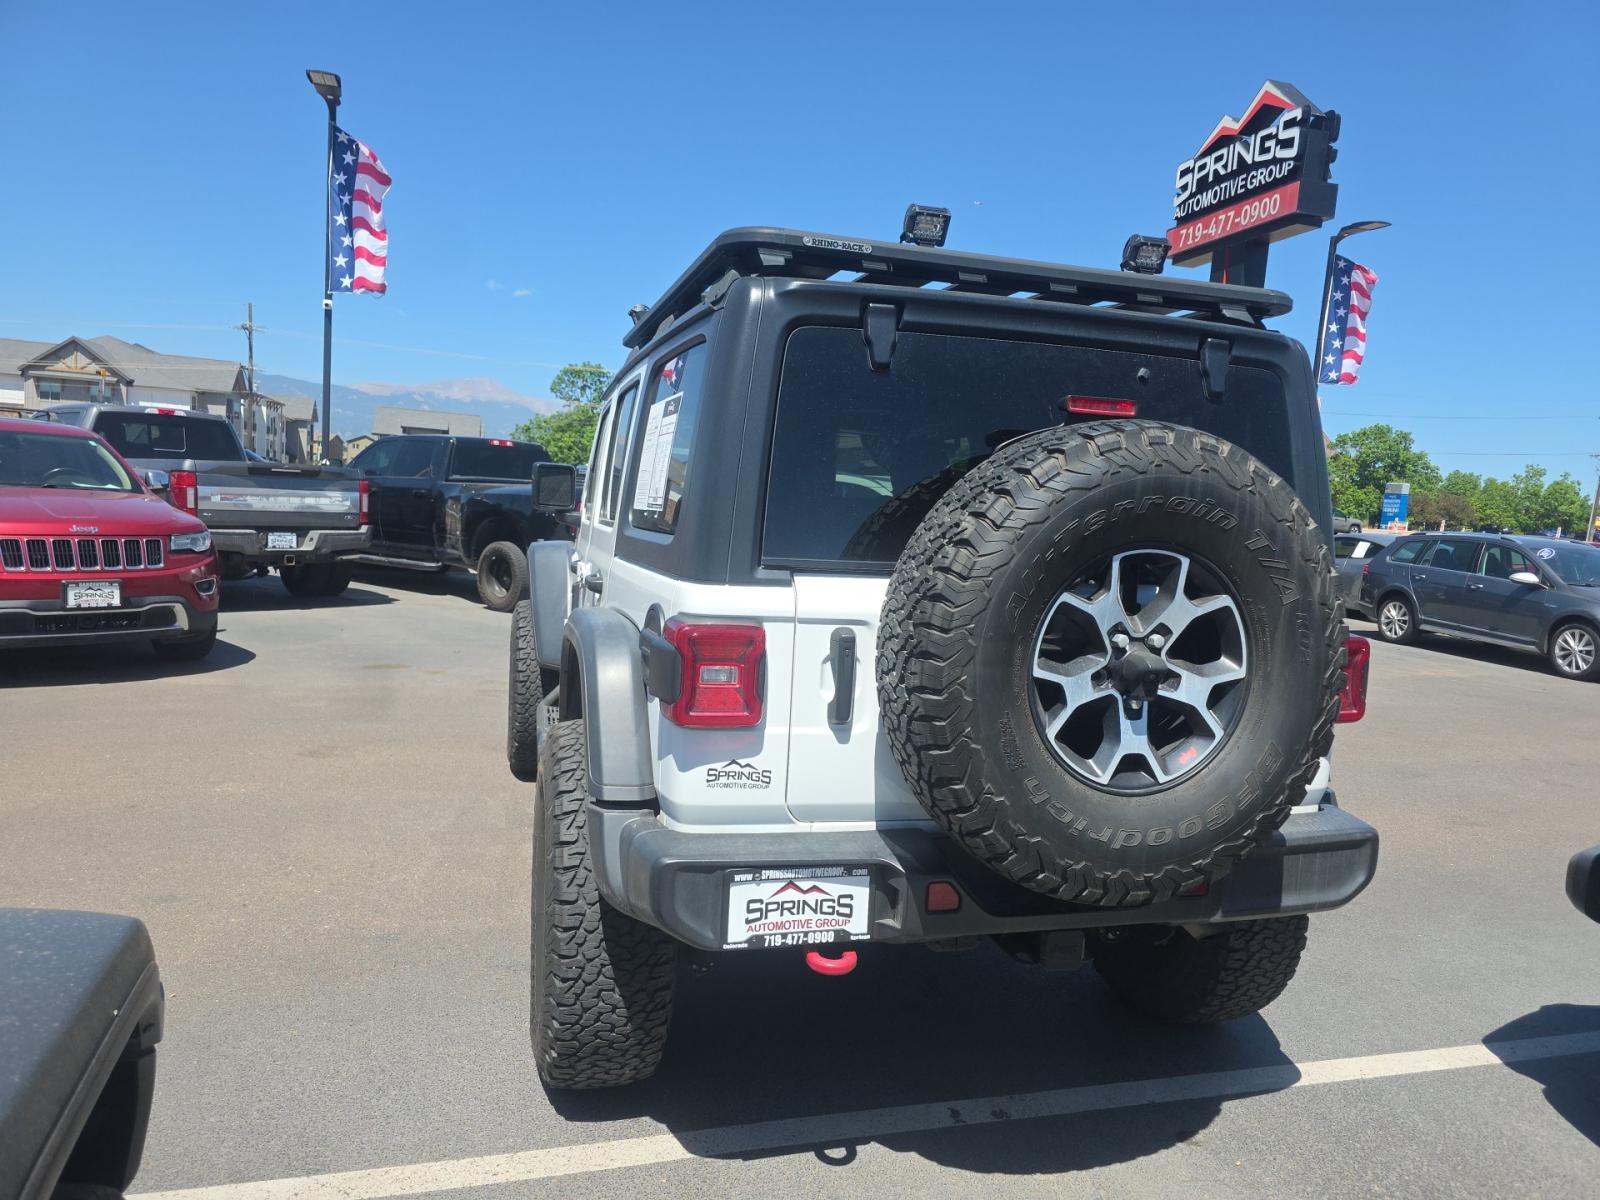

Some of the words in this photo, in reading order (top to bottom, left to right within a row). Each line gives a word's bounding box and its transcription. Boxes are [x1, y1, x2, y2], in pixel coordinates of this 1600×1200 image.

[1173, 107, 1303, 208] SPRINGS
[1173, 174, 1247, 220] AUTOMOTIVE
[1246, 160, 1295, 190] GROUP
[1179, 194, 1281, 248] 719-477-0900
[811, 237, 865, 253] RHINO-RACK
[69, 524, 99, 534] Jeep
[73, 590, 115, 601] SPRINGS
[706, 768, 772, 785] SPRINGS
[745, 894, 853, 925] SPRINGS
[746, 918, 813, 934] AUTOMOTIVE
[815, 917, 851, 928] GROUP
[764, 931, 835, 947] 719-477-0900
